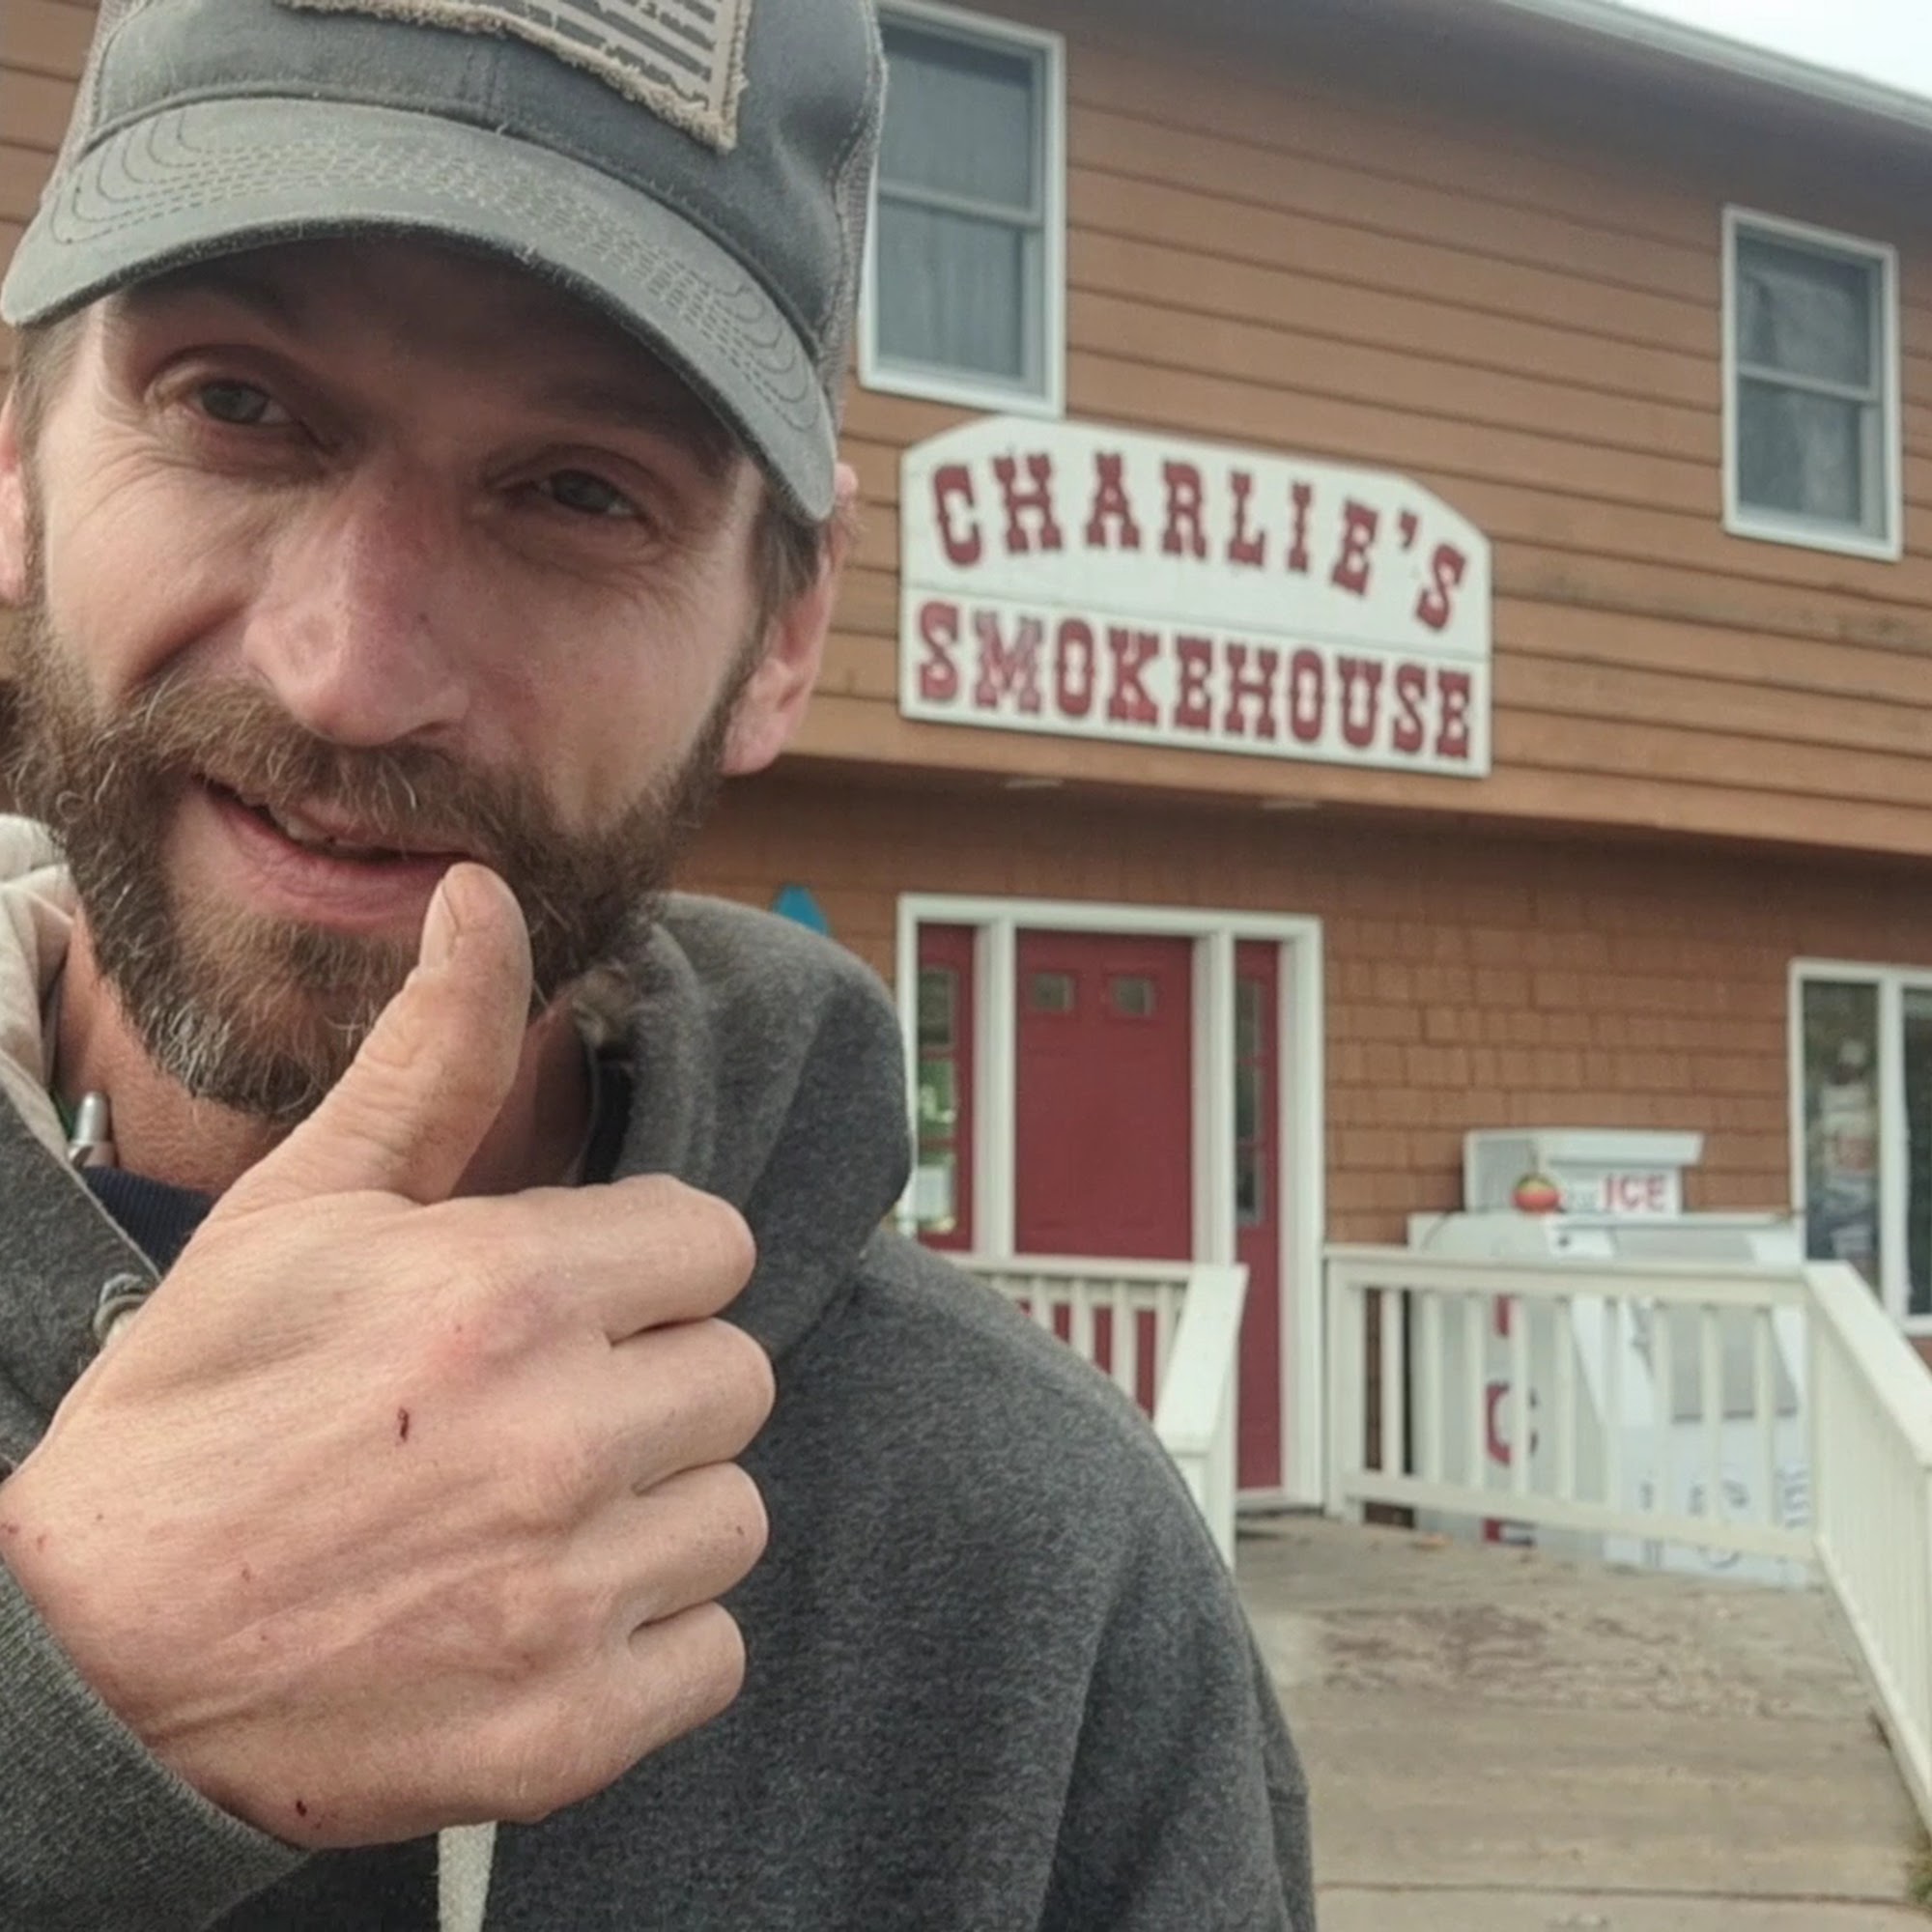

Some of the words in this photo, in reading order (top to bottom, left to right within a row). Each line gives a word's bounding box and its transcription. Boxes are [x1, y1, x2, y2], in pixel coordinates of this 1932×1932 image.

[932, 451, 1467, 631] CHARLIE'S
[920, 600, 1471, 759] SMOKEHOUSE
[1604, 1174, 1665, 1212] ICE
